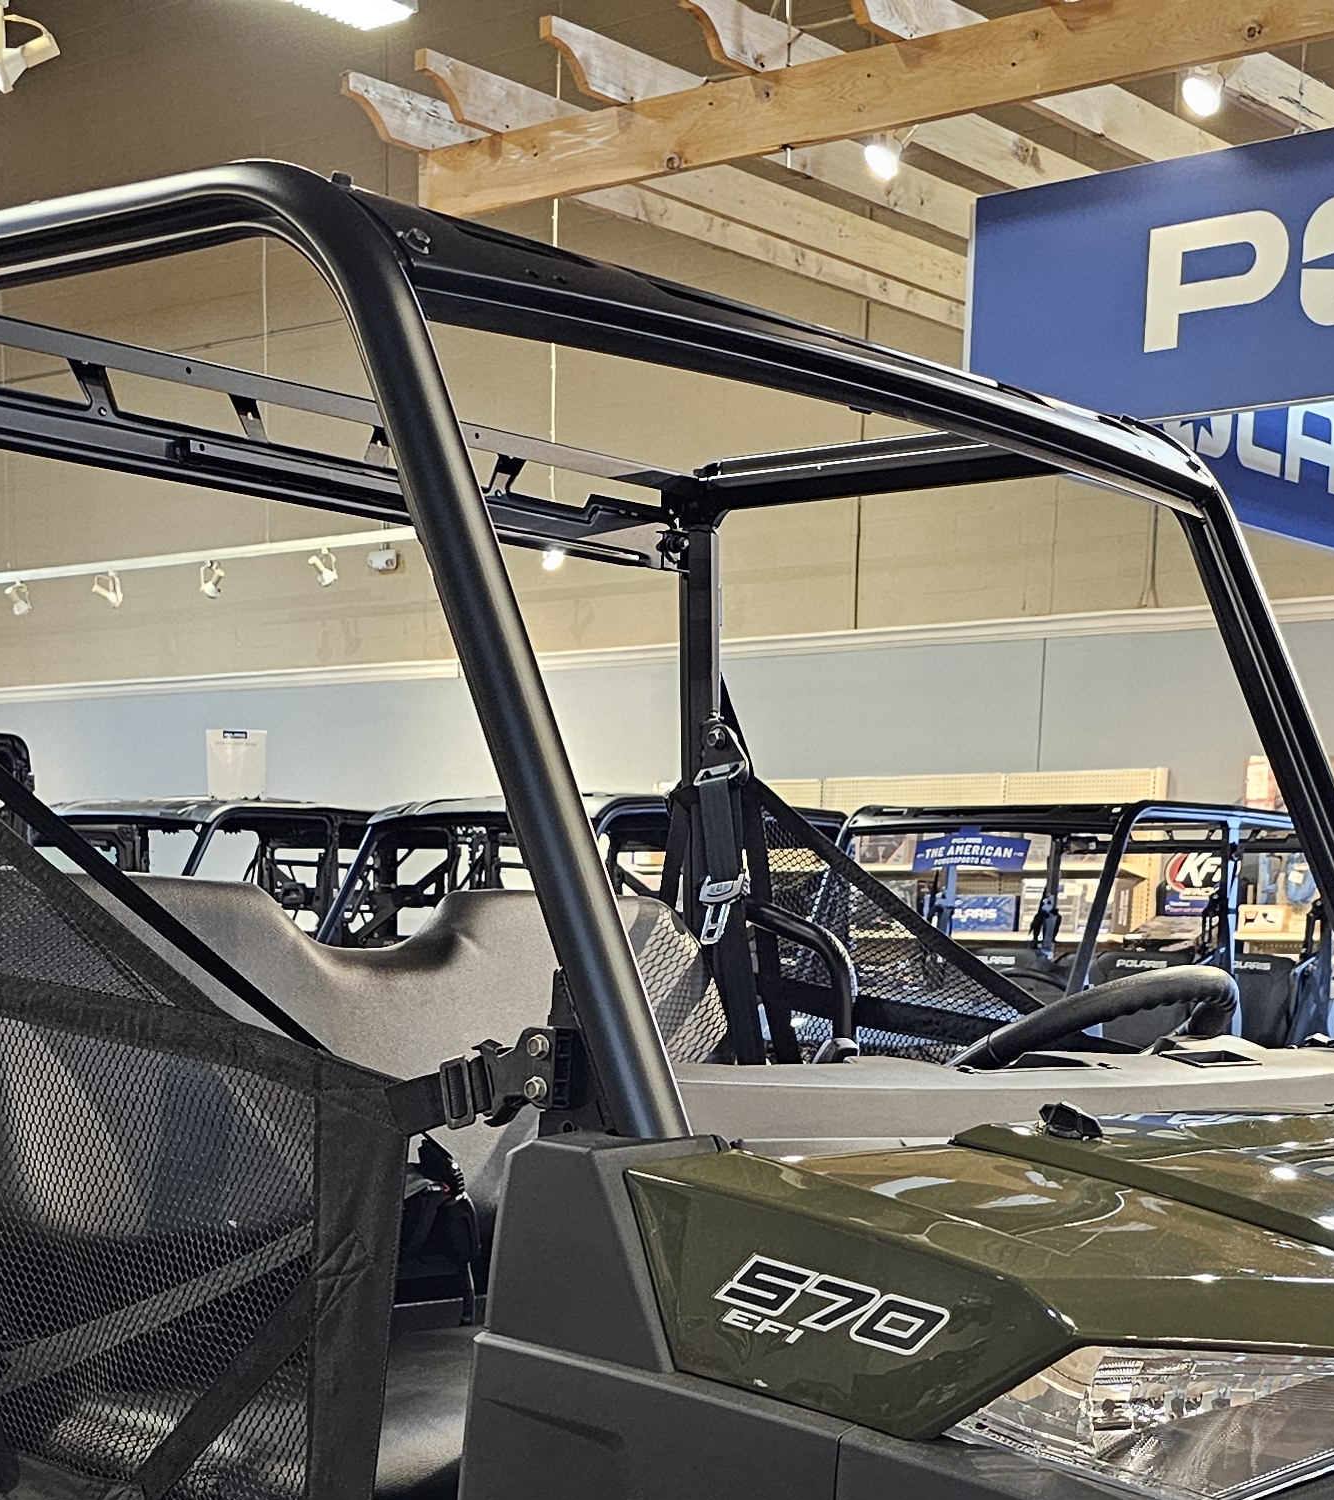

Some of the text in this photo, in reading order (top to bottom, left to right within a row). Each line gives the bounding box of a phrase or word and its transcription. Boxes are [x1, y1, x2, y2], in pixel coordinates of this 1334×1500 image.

[924, 844, 1014, 859] THE AMERICAN
[1116, 959, 1168, 969] POLARIS
[713, 1252, 951, 1356] 570
[721, 1307, 805, 1345] EFI
